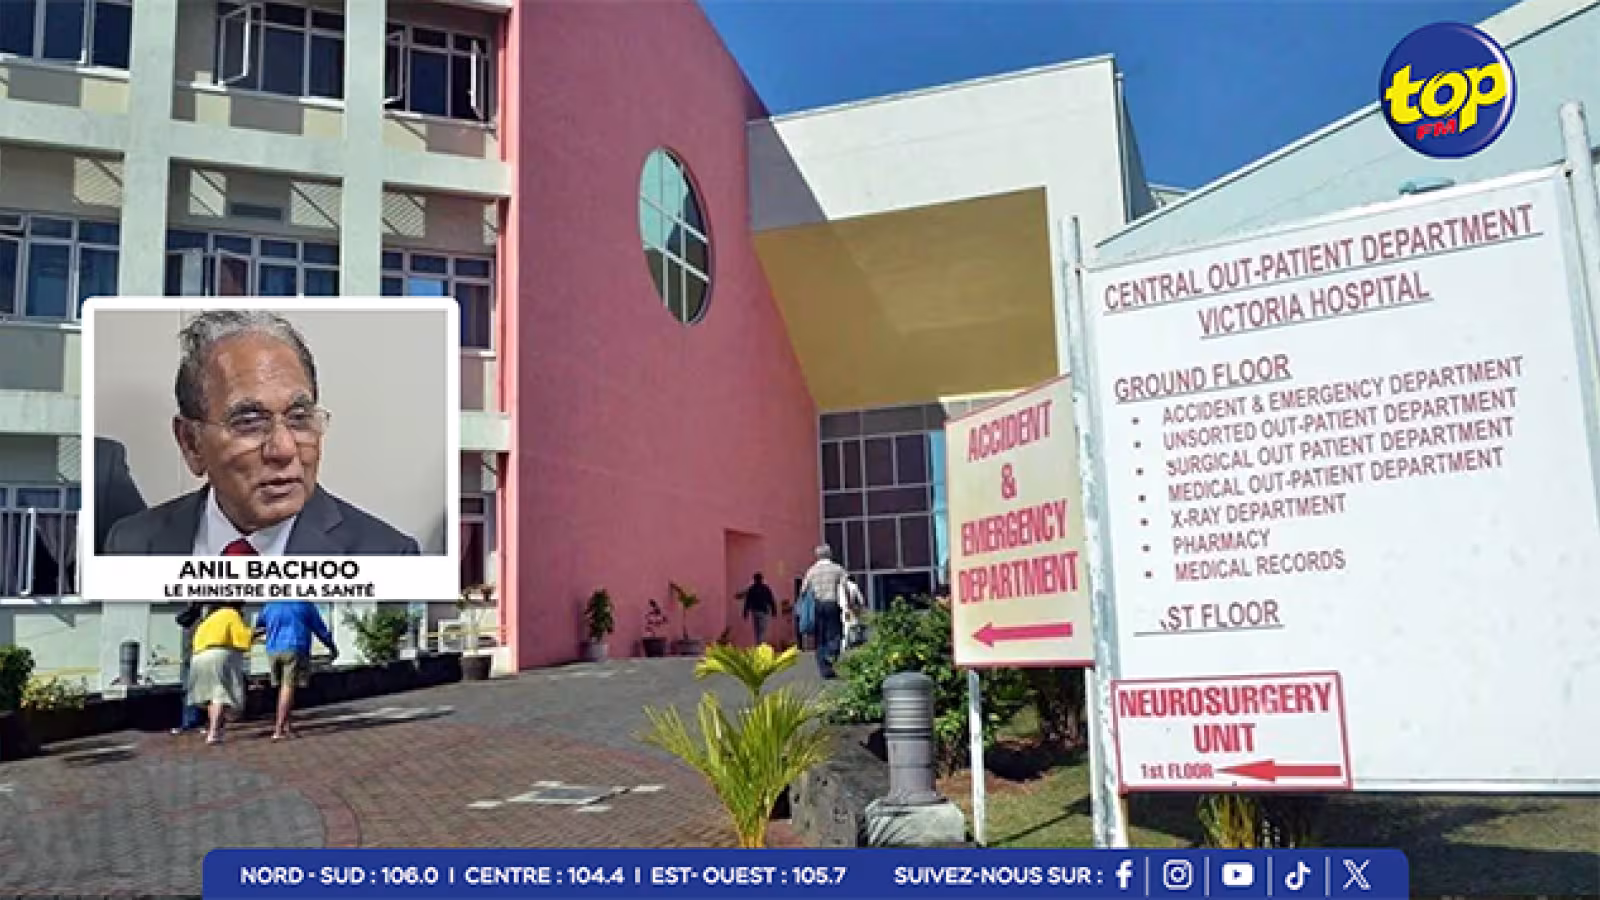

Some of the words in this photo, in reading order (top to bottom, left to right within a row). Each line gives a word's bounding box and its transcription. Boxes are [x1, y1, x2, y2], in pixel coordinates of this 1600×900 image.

[1105, 269, 1203, 310] CENTRAL
[1208, 237, 1353, 291] OUT-PATIENT
[1361, 203, 1533, 263] DEPARTMENT
[1198, 292, 1304, 334] VICTORIA
[1310, 271, 1429, 317] HOSPITAL
[1115, 366, 1206, 401] GROUND
[1212, 353, 1291, 386] FLOOR
[1163, 397, 1246, 424] ACCIDENT
[1252, 395, 1264, 414] &
[1270, 376, 1384, 411] EMERGENCY
[1389, 356, 1523, 395] DEPARTMENT
[968, 400, 1052, 462] ACCIDENT
[1163, 422, 1257, 450] UNSORTED
[1261, 406, 1377, 438] OUT-PATIENT
[1384, 387, 1516, 423] DEPARTMENT
[1257, 443, 1294, 465] OUT
[1300, 434, 1373, 460] PATIENT
[1381, 417, 1513, 451] DEPARTMENT
[1001, 463, 1017, 499] &
[1168, 478, 1244, 502] MEDICAL
[1249, 463, 1364, 493] OUT-PATIENT
[1371, 447, 1503, 481] DEPARTMENT
[961, 499, 1067, 556] EMERGENCY
[1171, 505, 1221, 528] X-RAY
[1226, 493, 1346, 523] DEPARTMENT
[1174, 528, 1270, 554] PHARMACY
[1176, 558, 1252, 581] MEDICAL
[1256, 549, 1346, 575] RECORDS
[958, 551, 1079, 604] DEPARTMENT
[1201, 598, 1280, 627] FLOOR
[1119, 682, 1331, 718] NEUROSURGERY
[1194, 723, 1256, 753] UNIT
[1140, 763, 1165, 780] 1st
[1168, 761, 1214, 780] FLOOR
